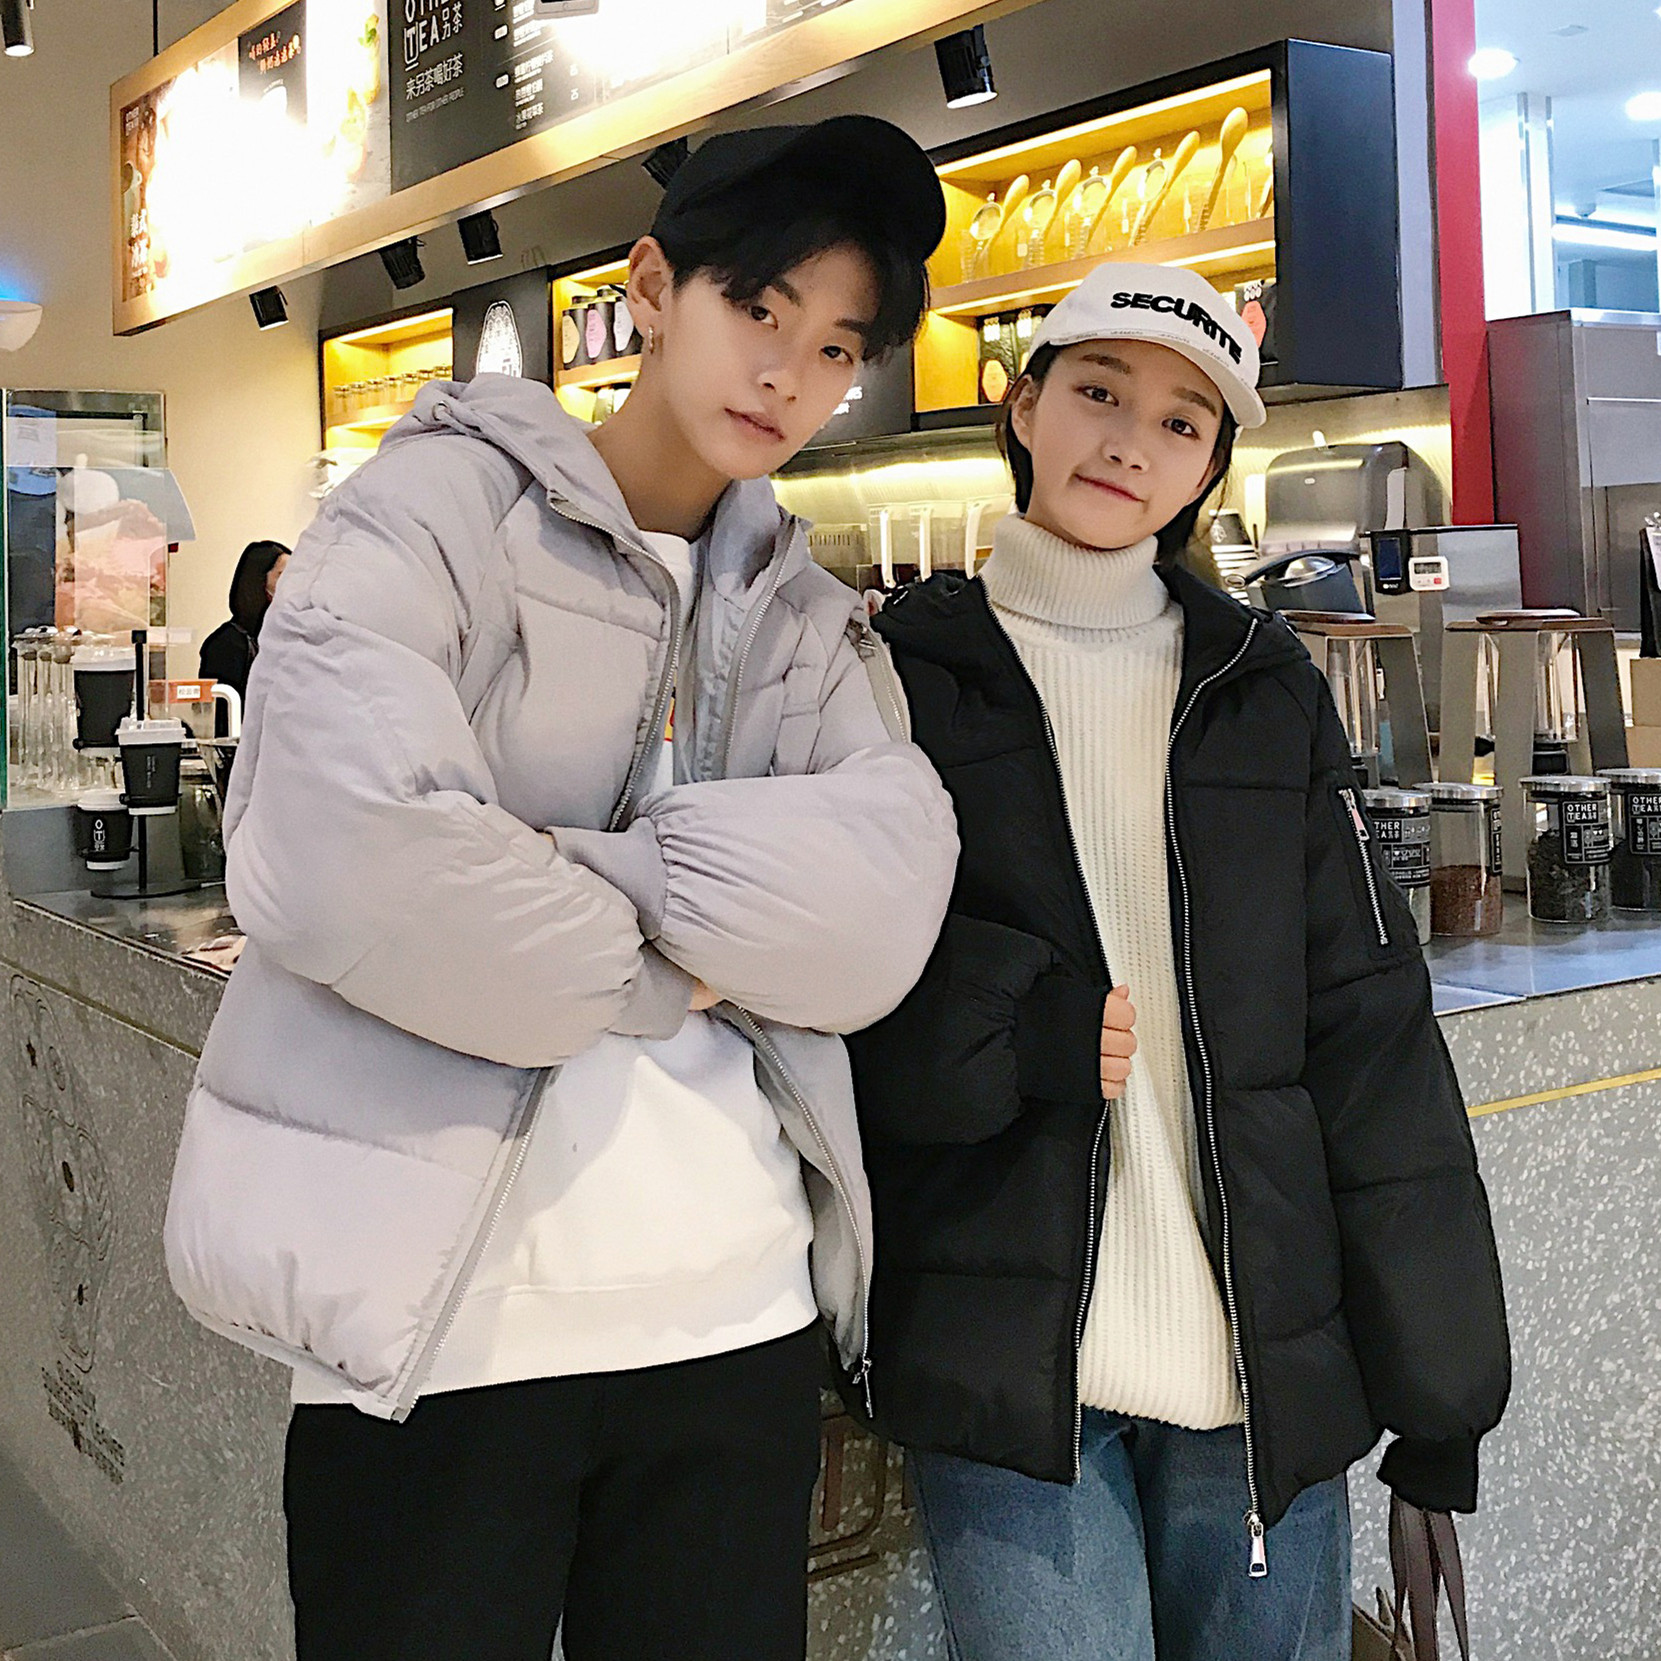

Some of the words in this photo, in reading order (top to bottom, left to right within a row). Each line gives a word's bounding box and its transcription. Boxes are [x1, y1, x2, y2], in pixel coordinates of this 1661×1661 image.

[406, 53, 463, 100] 来另茶喝好茶
[1567, 803, 1597, 812] OTHER
[1567, 812, 1587, 822] TEA
[1373, 821, 1400, 831] THER
